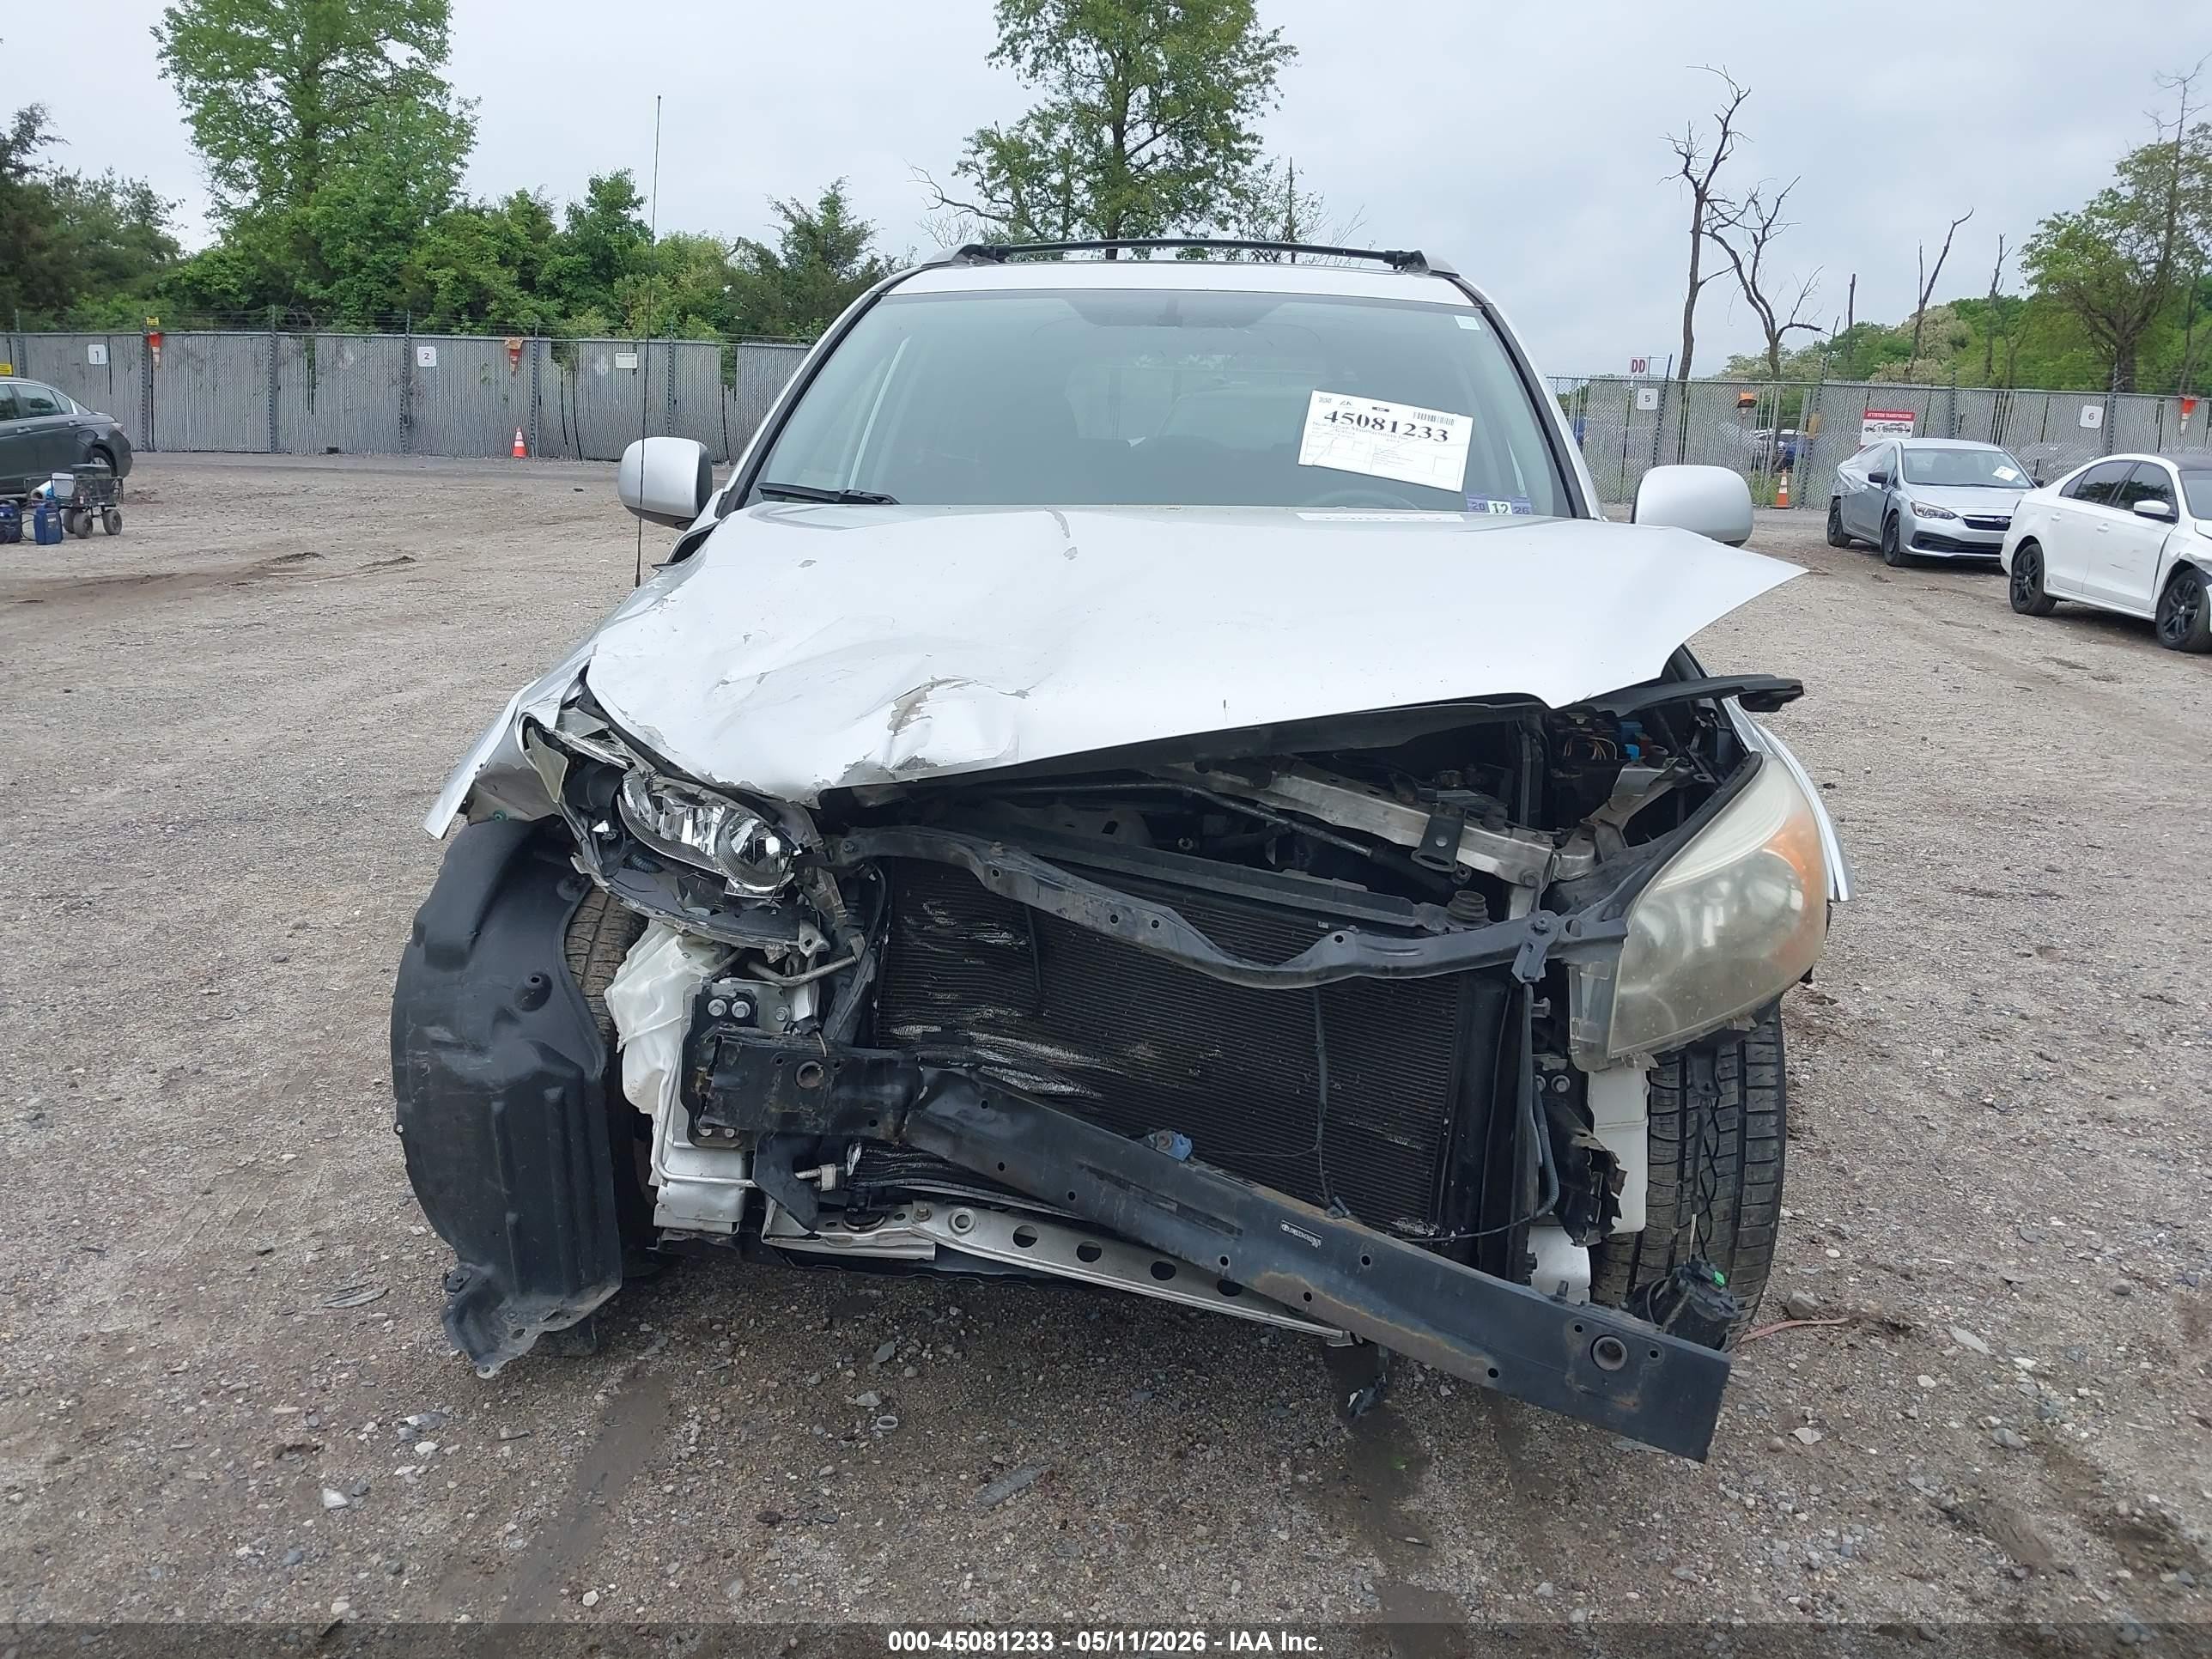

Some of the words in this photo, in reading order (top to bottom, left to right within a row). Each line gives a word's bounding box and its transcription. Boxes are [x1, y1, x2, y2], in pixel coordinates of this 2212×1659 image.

[423, 352, 430, 361] 2
[1631, 359, 1646, 374] DD
[1644, 394, 1651, 403] 5
[2088, 412, 2095, 421] 6
[1323, 410, 1449, 443] 45081233
[1471, 501, 1486, 511] 20
[1492, 502, 1509, 514] 12
